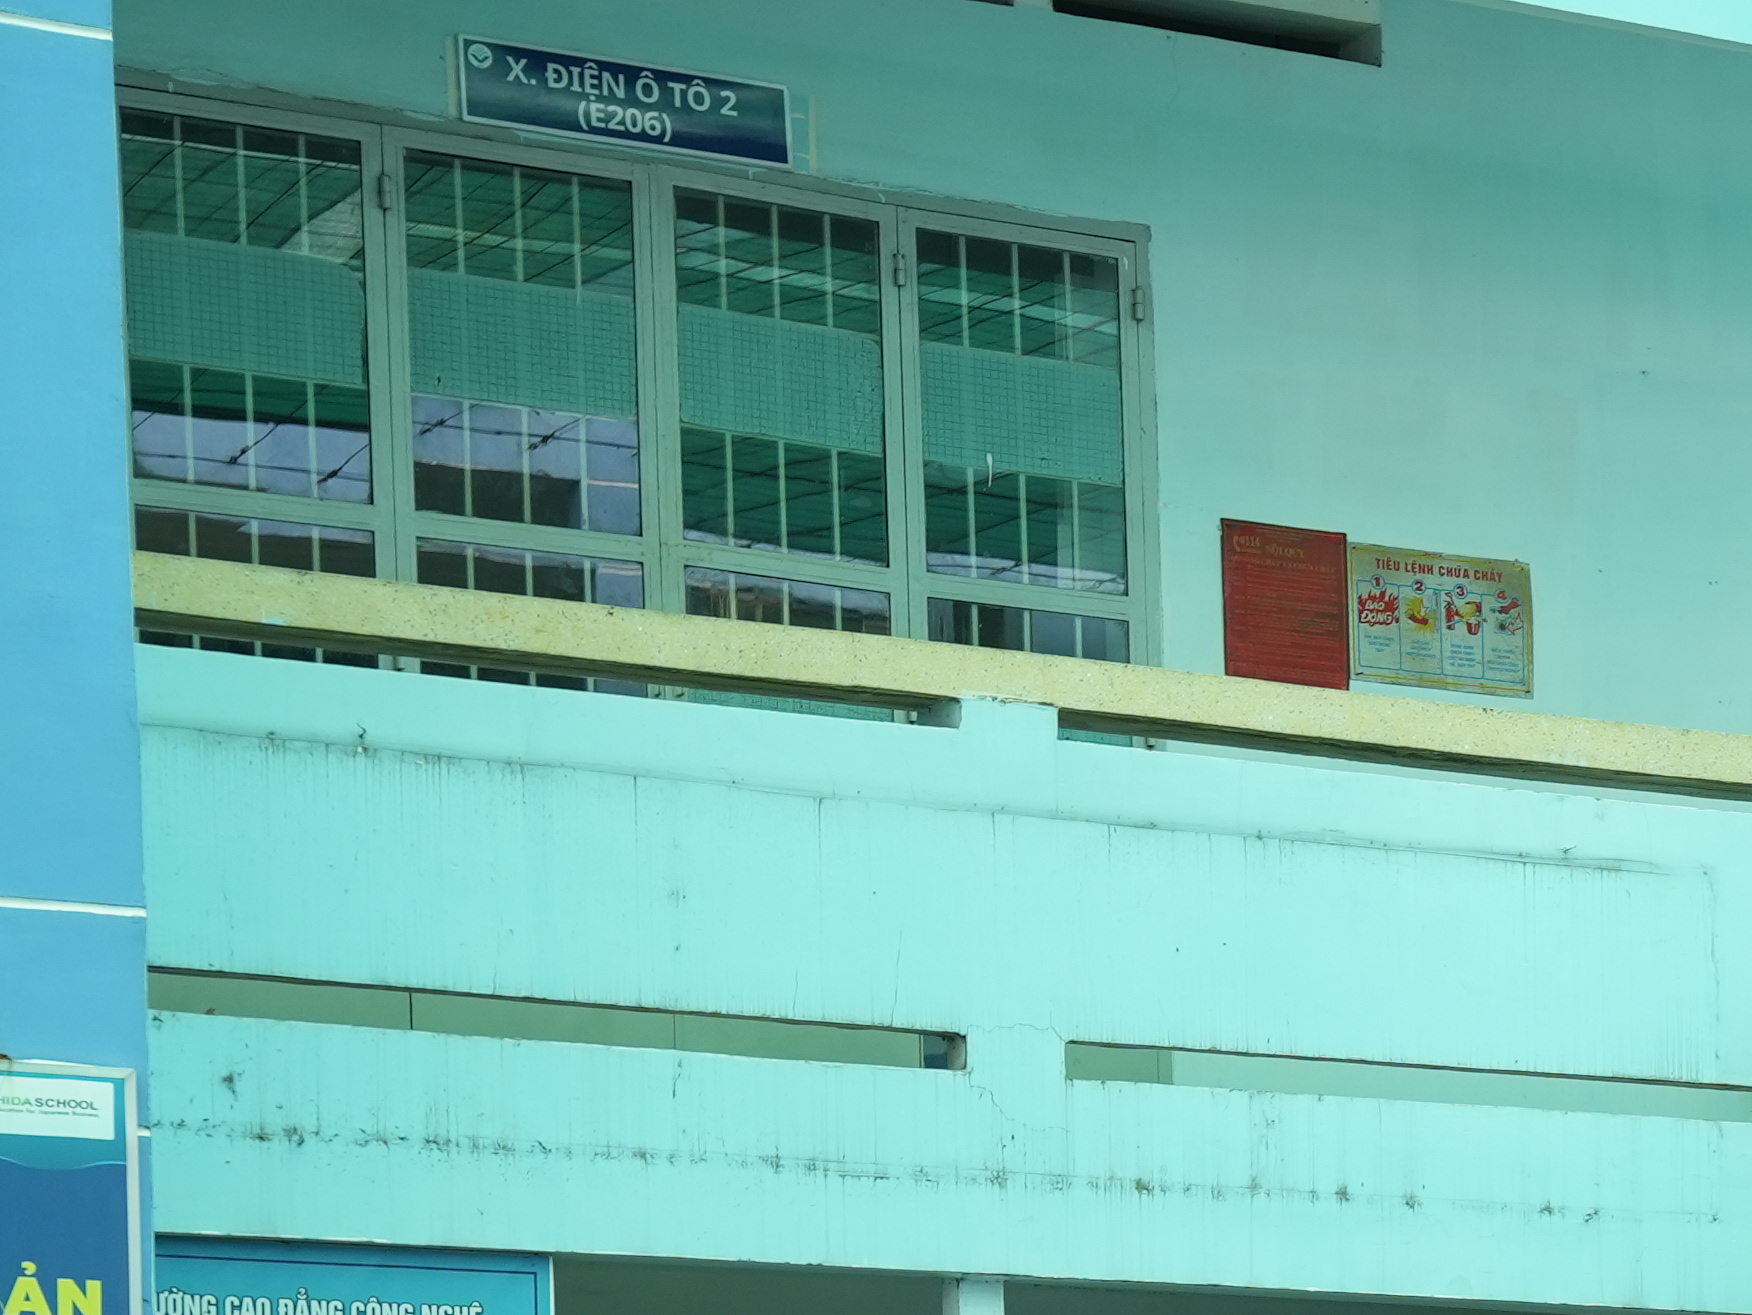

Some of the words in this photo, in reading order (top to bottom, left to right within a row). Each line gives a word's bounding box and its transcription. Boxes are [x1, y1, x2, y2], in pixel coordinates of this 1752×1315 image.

[505, 55, 537, 86] X.
[545, 61, 626, 103] ĐIỆN
[635, 70, 660, 104] Ô
[667, 78, 711, 112] TÔ
[719, 90, 739, 117] 2
[577, 100, 673, 143] (E206)
[1373, 576, 1383, 587] 1
[1414, 581, 1424, 592] 2
[1456, 586, 1466, 597] 3
[1375, 557, 1402, 573] TIÊU
[1404, 561, 1435, 578] LỆNH
[1438, 564, 1471, 580] CHỮA
[1473, 566, 1504, 583] CHÁY
